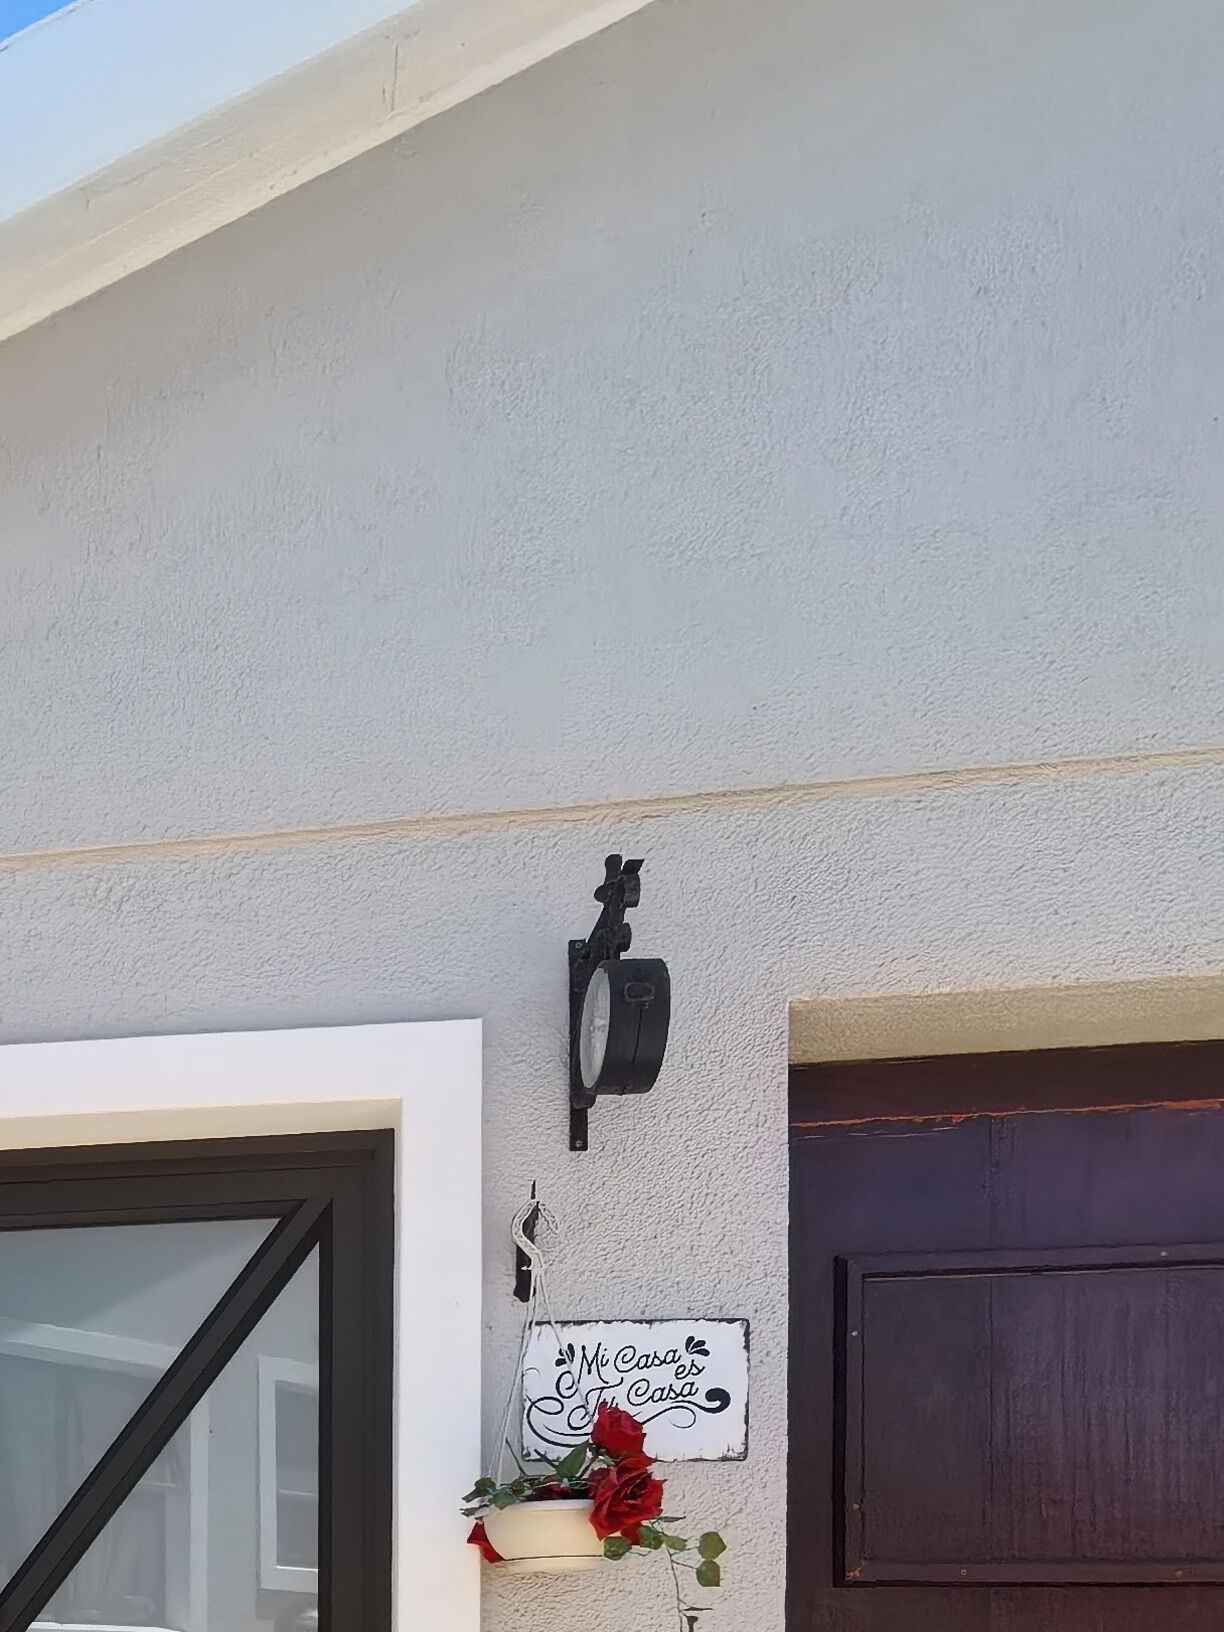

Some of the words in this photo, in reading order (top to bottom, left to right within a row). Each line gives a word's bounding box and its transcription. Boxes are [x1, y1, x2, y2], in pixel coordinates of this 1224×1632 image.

[613, 1345, 682, 1373] Casa
[675, 1359, 705, 1380] es
[626, 1378, 699, 1407] Casa
